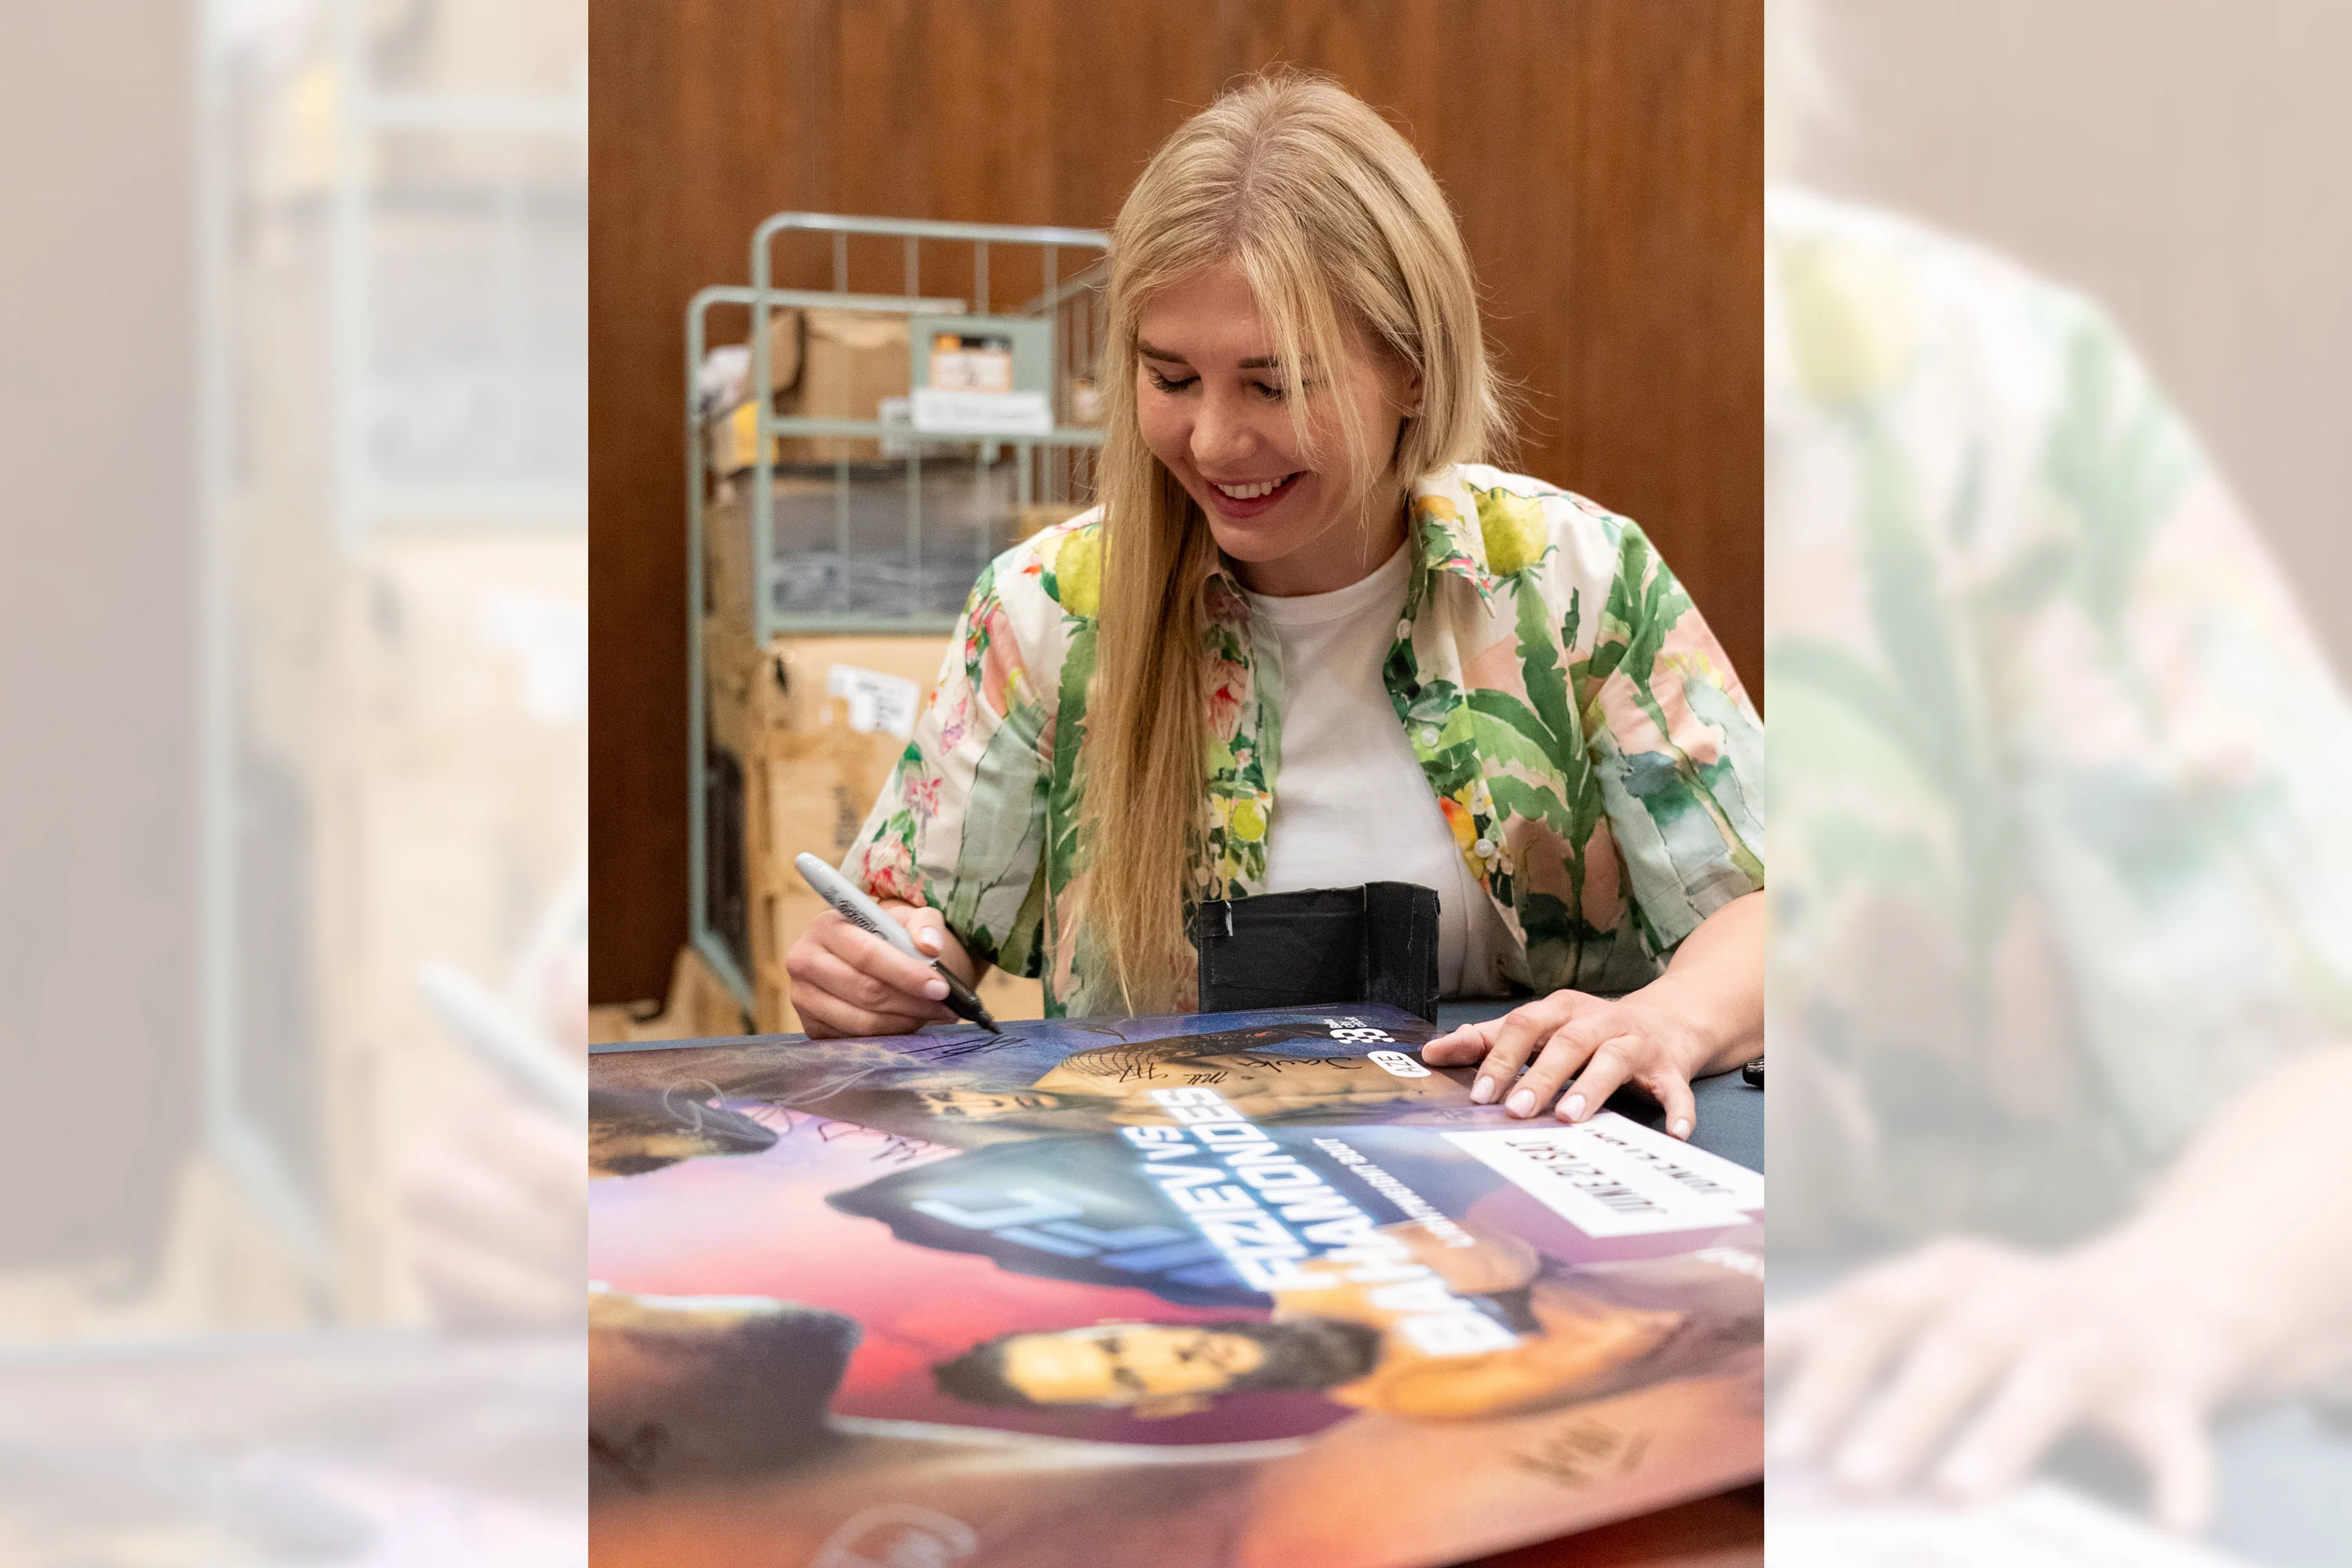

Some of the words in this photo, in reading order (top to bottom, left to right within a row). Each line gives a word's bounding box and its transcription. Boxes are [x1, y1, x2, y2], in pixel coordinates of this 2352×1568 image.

[1377, 1055, 1422, 1073] AZE
[1122, 1124, 1198, 1162] VS
[1504, 1140, 1578, 1160] SAT
[1573, 1180, 1668, 1214] JUNE
[1142, 1163, 1338, 1292] FIZIEV
[1151, 1086, 1519, 1356] BAHAMONDES
